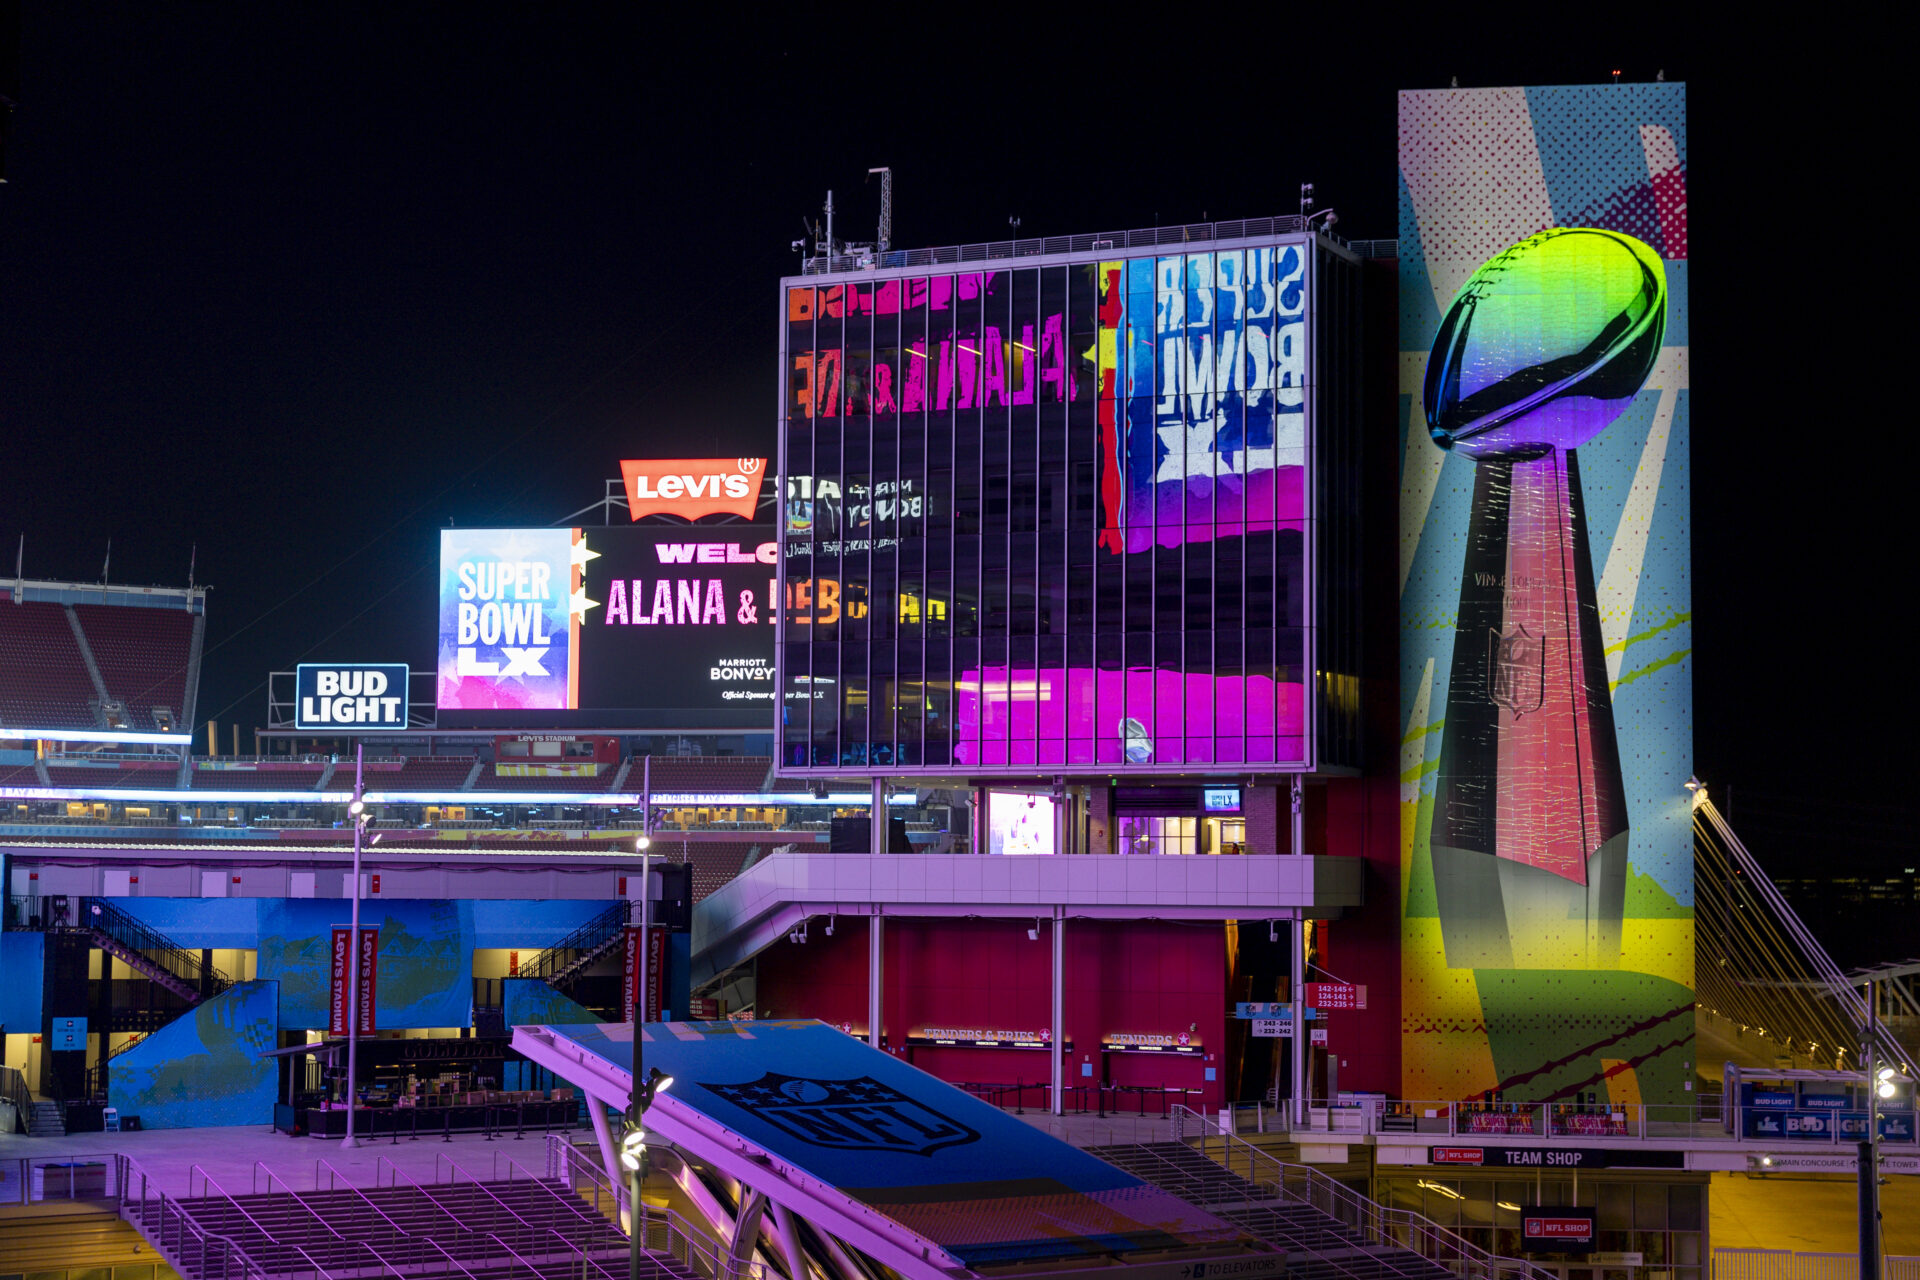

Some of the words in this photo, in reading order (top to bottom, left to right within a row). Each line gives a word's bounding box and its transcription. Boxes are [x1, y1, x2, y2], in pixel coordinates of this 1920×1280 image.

[458, 562, 550, 600] SUPER
[606, 580, 726, 624] ALANA
[737, 590, 757, 624] &
[458, 602, 551, 645] BOWL
[457, 647, 551, 676] LX
[719, 659, 766, 667] MARRIOTT
[317, 671, 388, 696] BUD
[710, 668, 775, 681] BONVOY
[333, 980, 343, 1032] STADIUM
[361, 980, 370, 1032] STADIUM
[1318, 1000, 1347, 1008] 232-235
[924, 1029, 983, 1041] TENDERS
[984, 1031, 994, 1041] &
[996, 1031, 1035, 1043] FRIES
[1111, 1033, 1173, 1046] TENDERS
[765, 1105, 961, 1146] NFL
[1505, 1151, 1542, 1164] TEAM
[1546, 1152, 1582, 1165] SHOP
[1546, 1224, 1563, 1232] NFL
[1564, 1224, 1589, 1232] SHOP
[1208, 1264, 1221, 1275] TO
[1222, 1259, 1277, 1274] ELEVATORS
